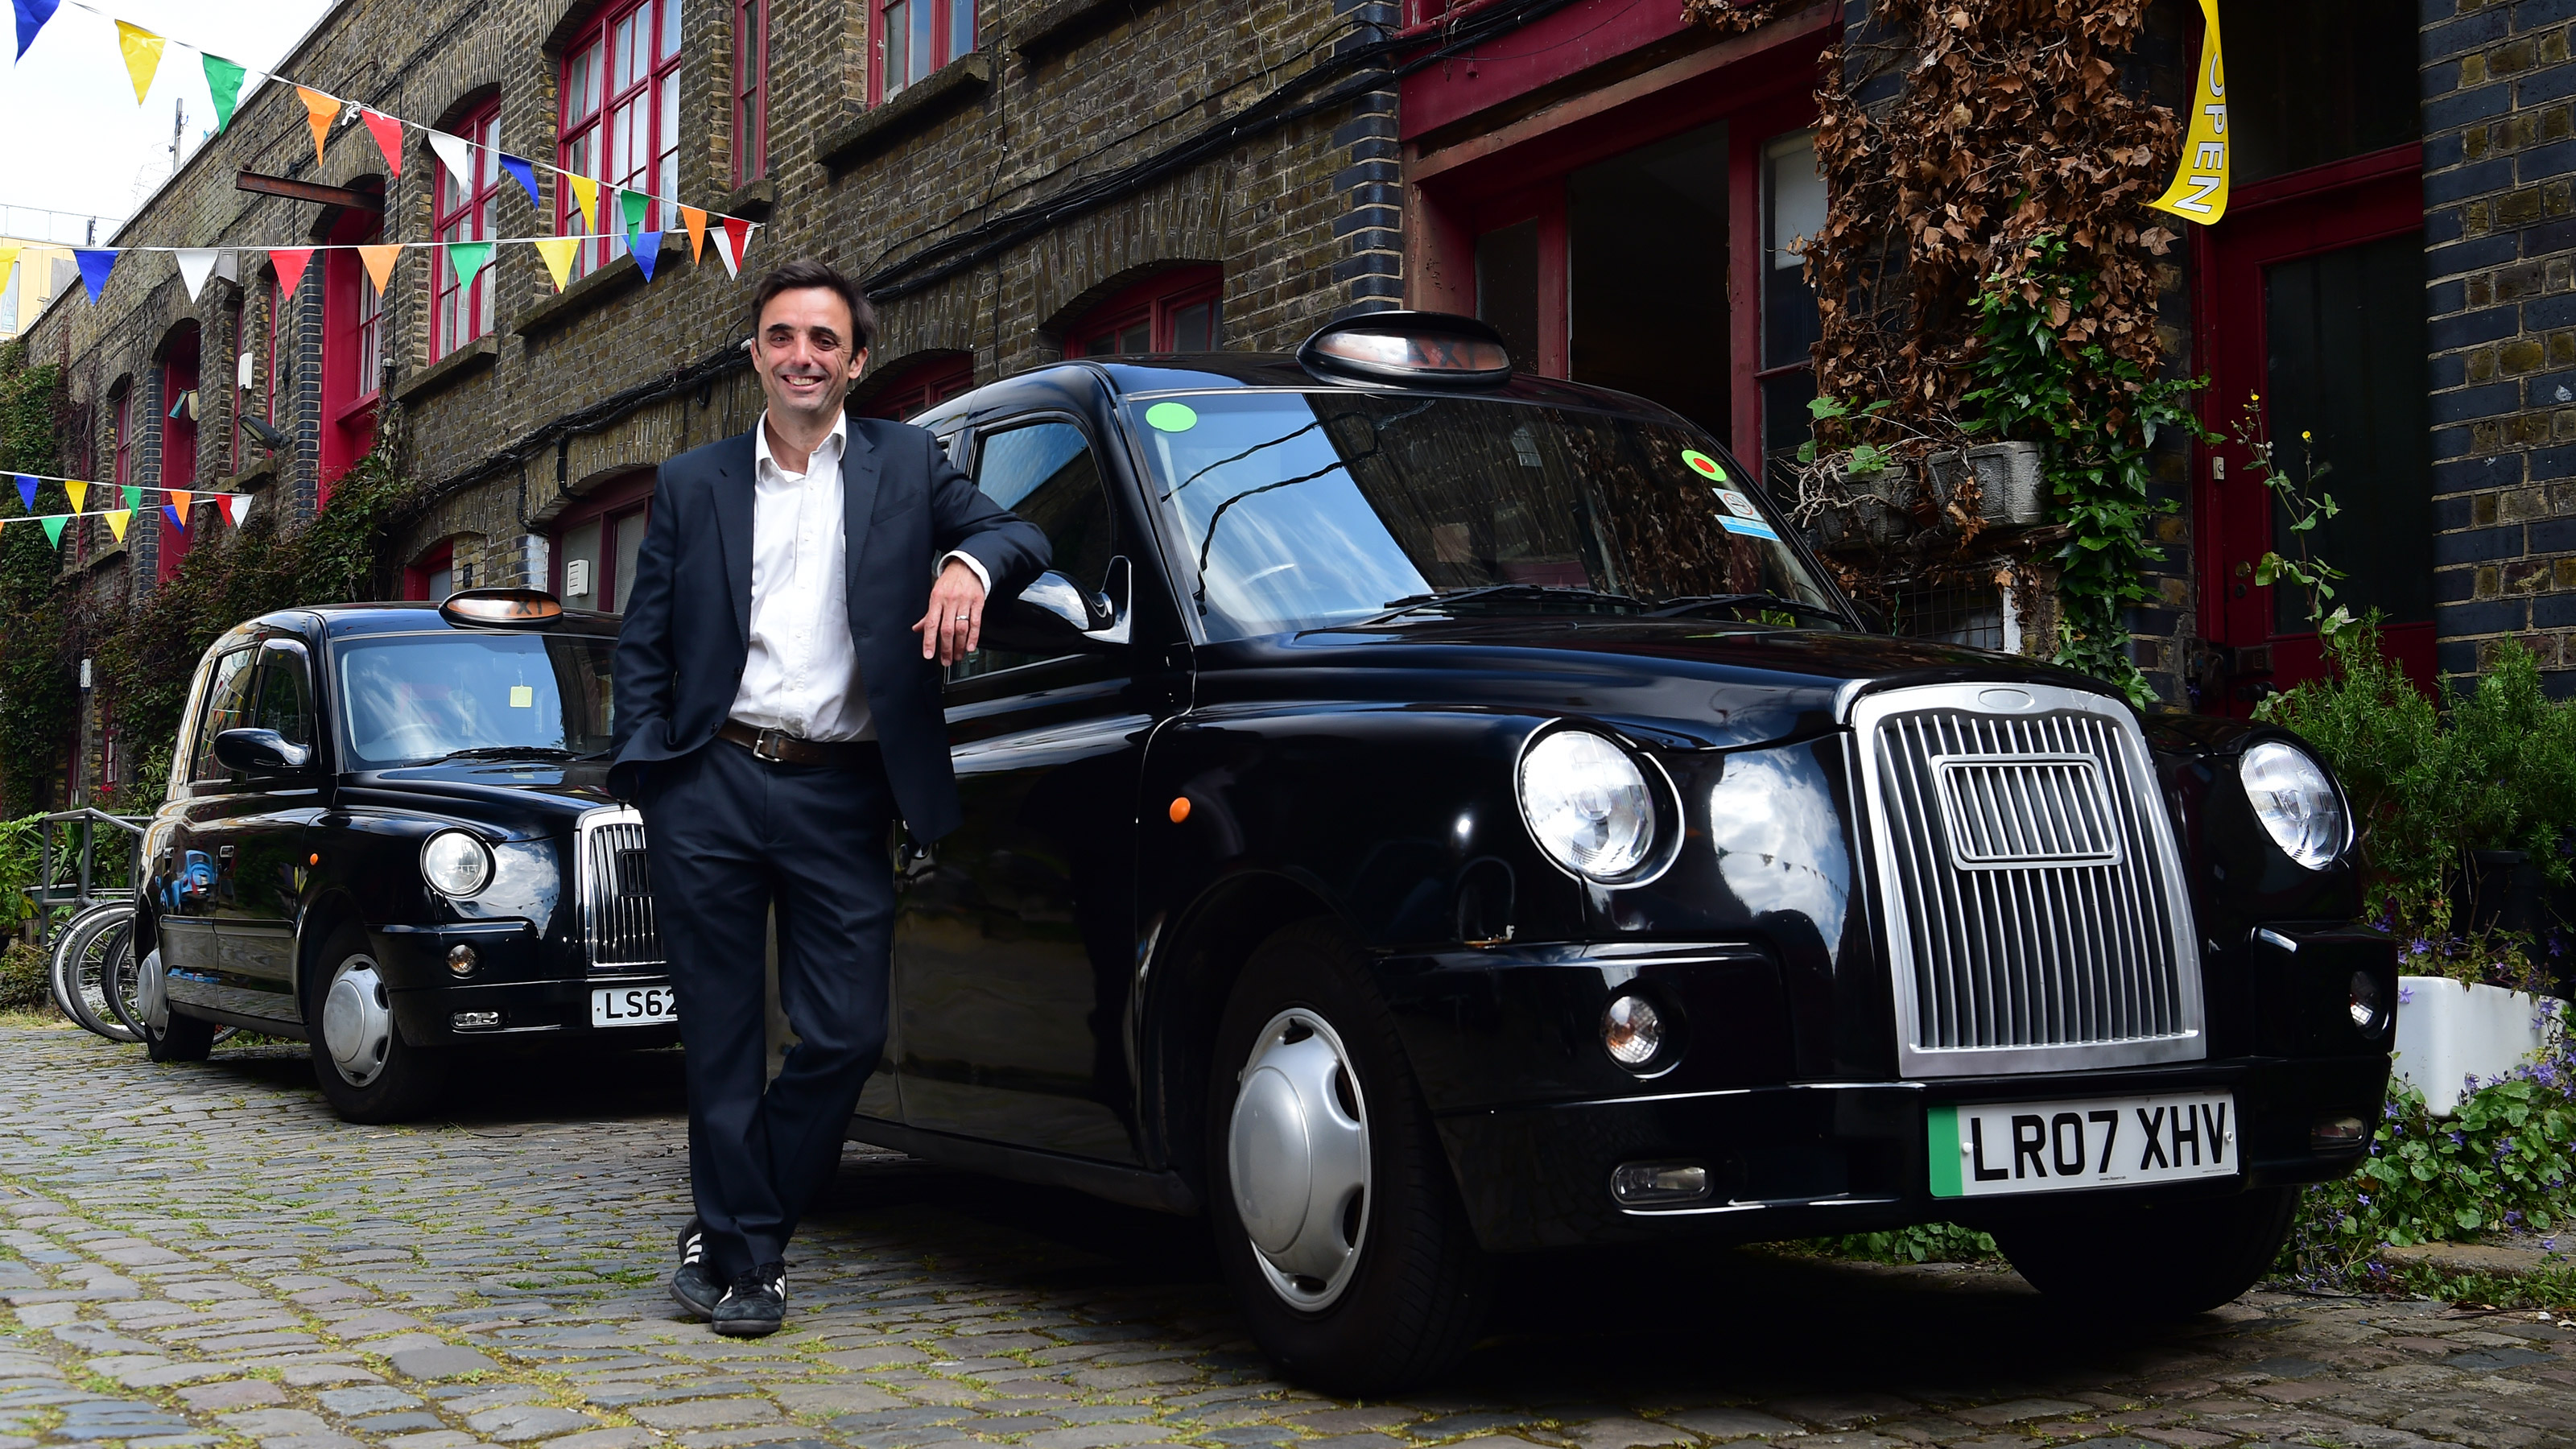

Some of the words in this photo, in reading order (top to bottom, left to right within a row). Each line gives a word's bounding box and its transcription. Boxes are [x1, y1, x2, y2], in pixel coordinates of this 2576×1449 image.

[605, 989, 678, 1019] LS62
[1970, 1109, 2119, 1182] LR07
[2136, 1102, 2227, 1170] XHV
